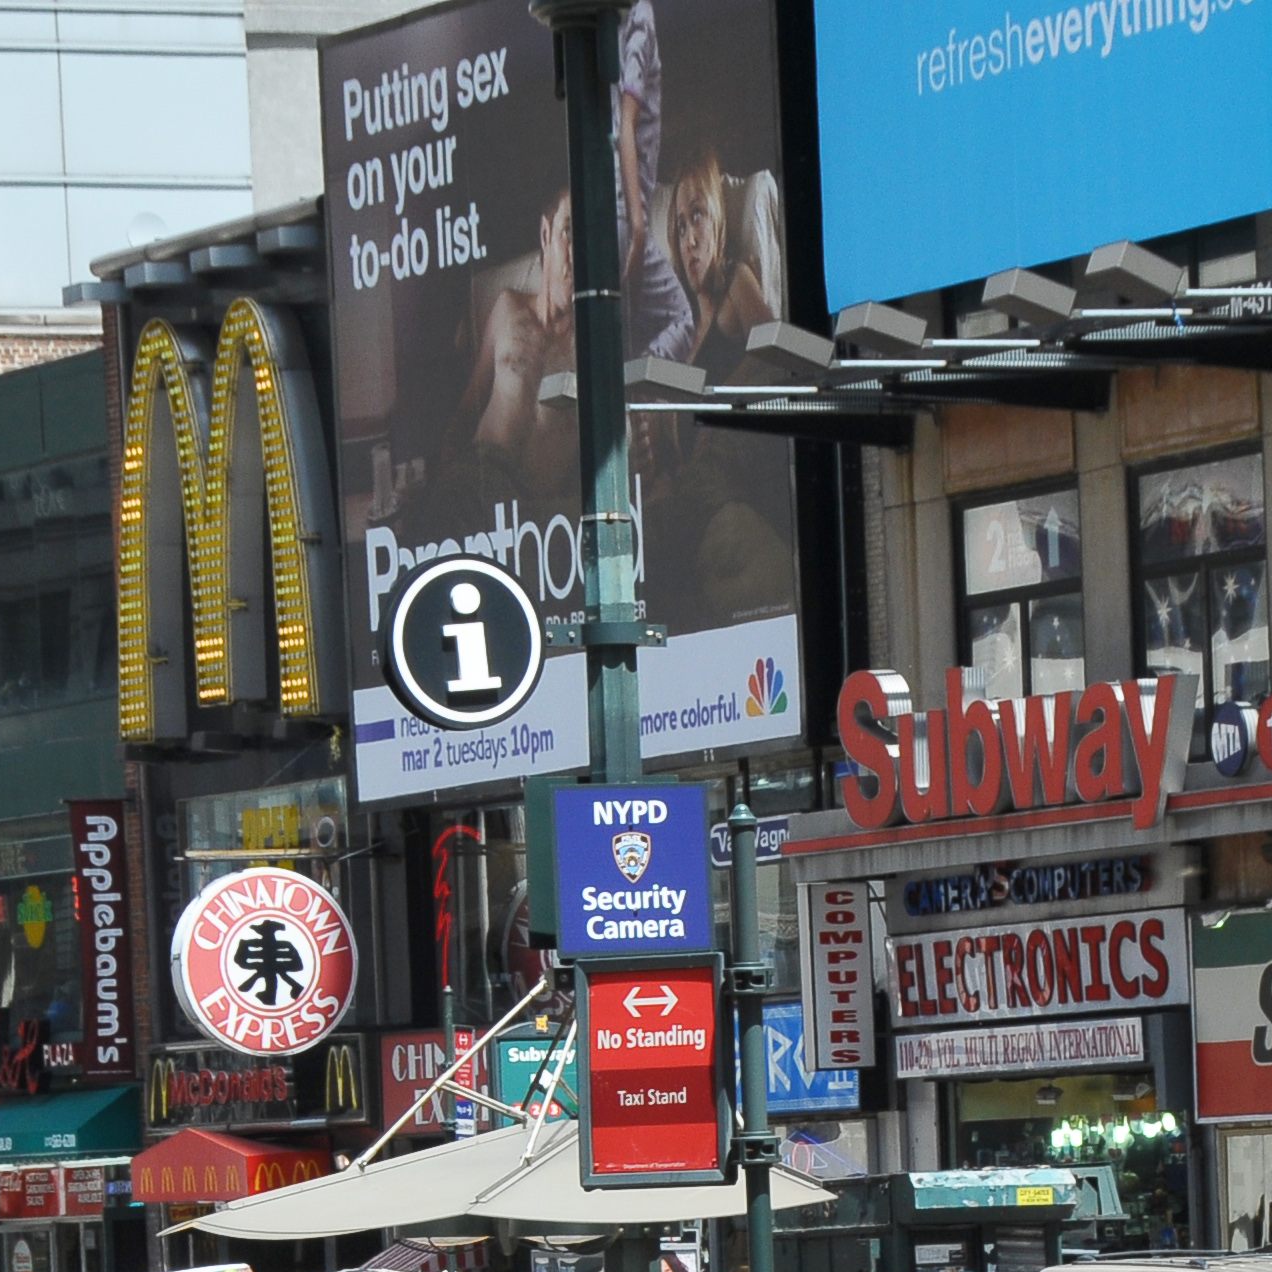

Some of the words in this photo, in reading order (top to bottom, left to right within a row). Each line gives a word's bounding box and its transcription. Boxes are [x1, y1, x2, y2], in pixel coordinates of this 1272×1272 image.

[915, 0, 1254, 95] refresheverything.
[343, 63, 448, 141] Putting
[456, 46, 509, 109] sex
[347, 153, 384, 211] on
[390, 134, 457, 214] your
[350, 218, 428, 290] to-do
[436, 202, 487, 269] list.
[366, 473, 645, 633] Prnthod
[640, 705, 678, 736] more
[680, 692, 741, 729] colorful.
[402, 749, 430, 772] mar
[433, 737, 443, 768] 2
[446, 731, 507, 769] tuesdays
[510, 723, 555, 764] 10pm
[837, 665, 1175, 830] Subway
[1212, 721, 1242, 764] MTA
[593, 799, 668, 825] NYPD
[194, 877, 348, 956] CHINATOWN
[582, 884, 687, 914] Security
[80, 815, 128, 1064] Applebaum's
[586, 915, 685, 940] Camera
[819, 889, 864, 1065] COMPUTERS
[895, 918, 1170, 1018] ELECTRONICS
[199, 986, 339, 1049] EXPRESS
[597, 1029, 622, 1050] No
[625, 1025, 706, 1051] Standing
[43, 1043, 76, 1067] PLAZA
[508, 1046, 576, 1065] Subway
[964, 1035, 999, 1068] MULTI
[1002, 1031, 1045, 1063] REGION
[1048, 1023, 1140, 1061] INTERNATIONAL
[168, 1064, 289, 1109] McDonald's
[617, 1089, 645, 1107] Taxi
[647, 1087, 687, 1106] Stand
